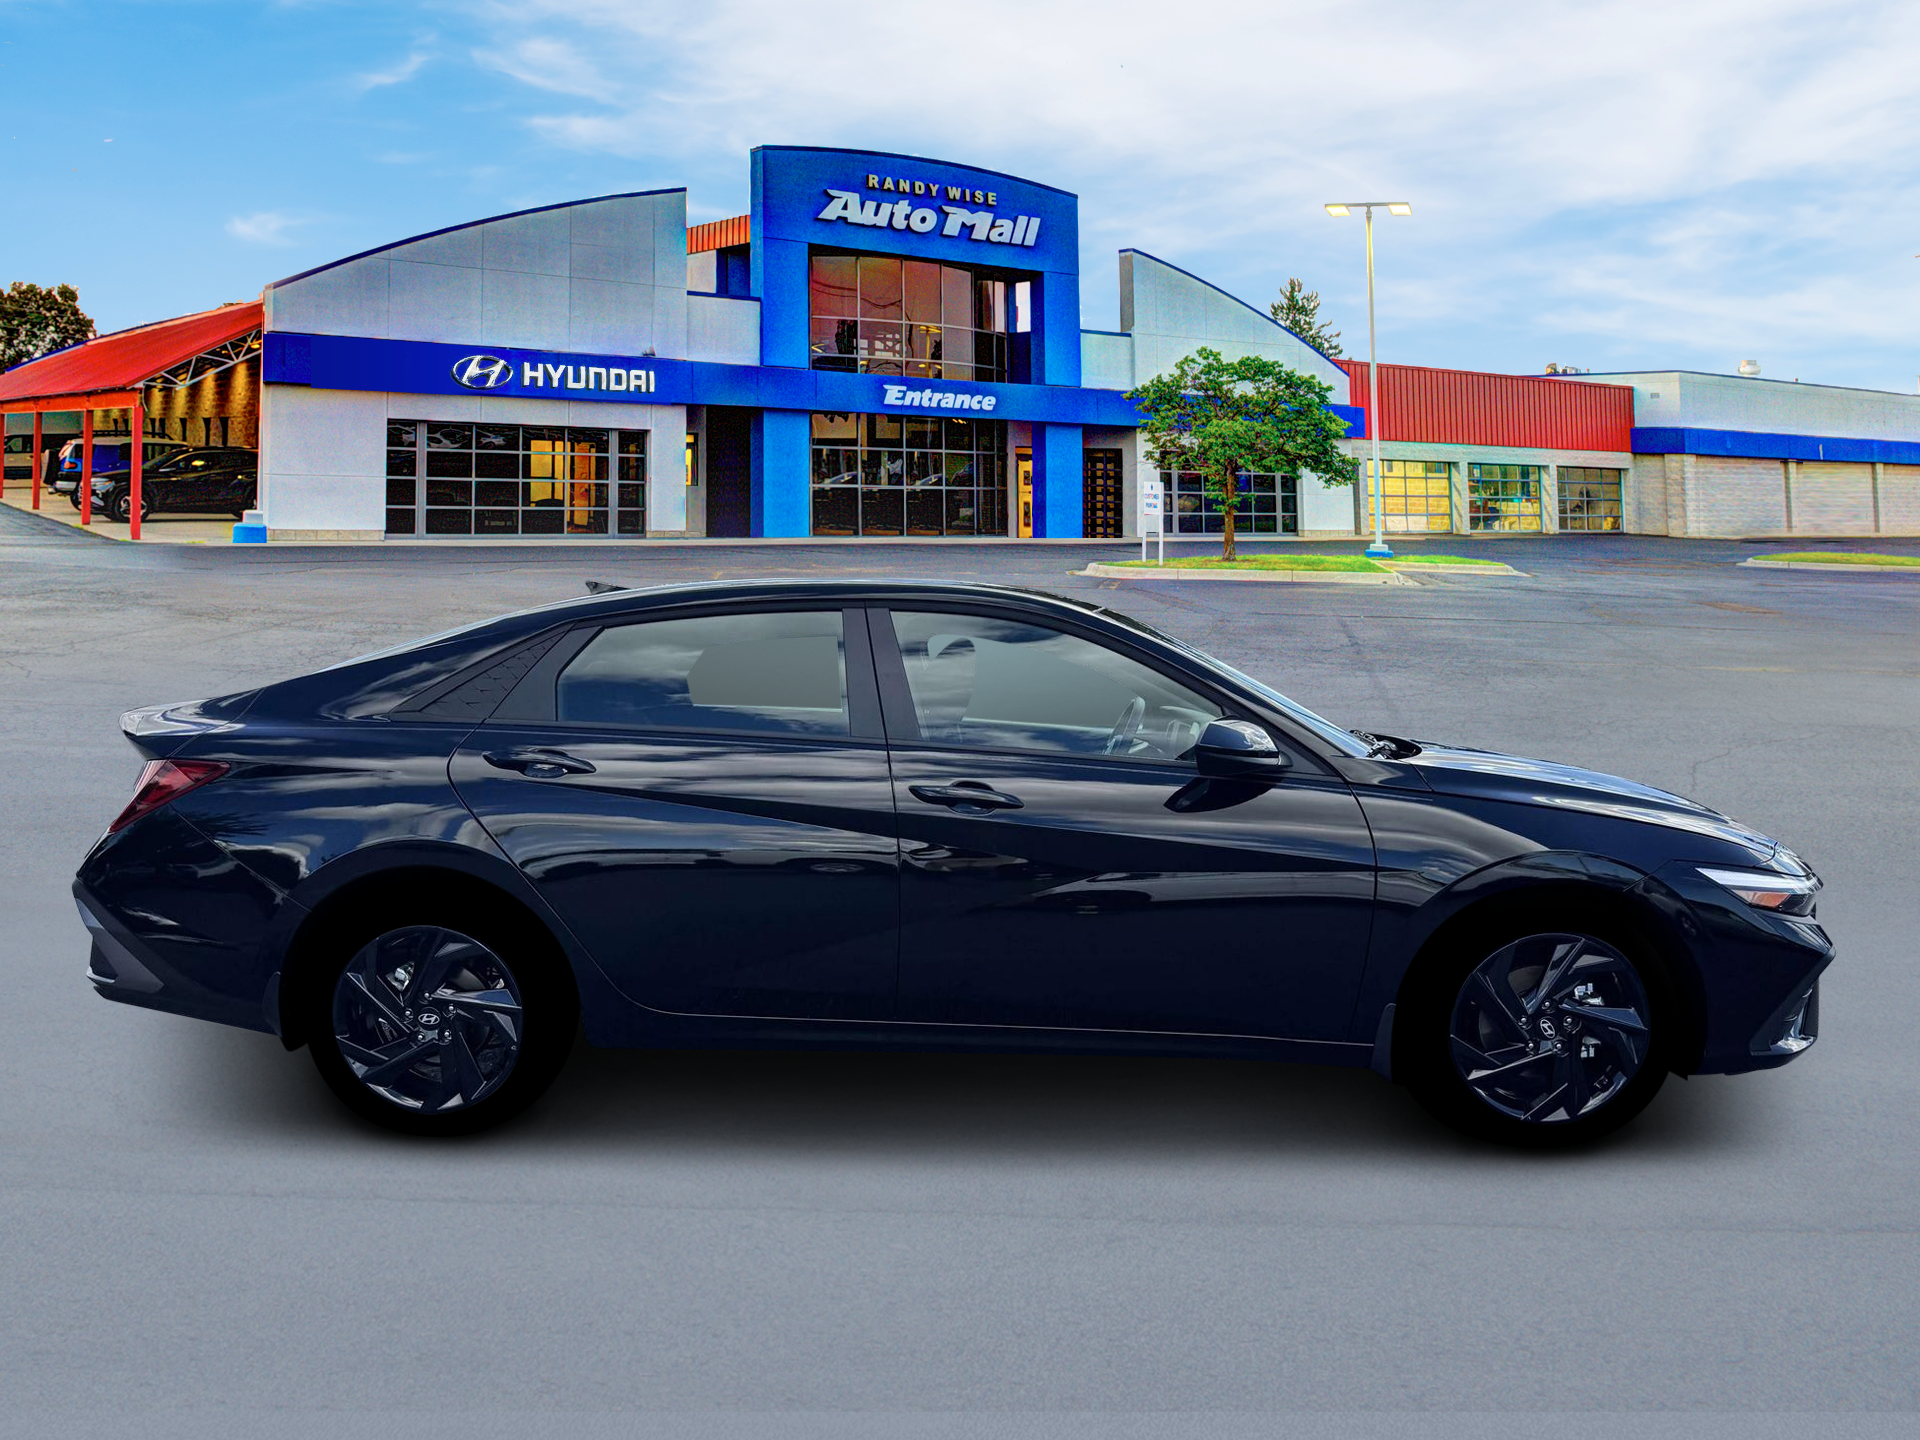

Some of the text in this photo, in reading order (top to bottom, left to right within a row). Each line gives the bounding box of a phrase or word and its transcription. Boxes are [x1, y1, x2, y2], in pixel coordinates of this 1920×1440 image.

[868, 174, 997, 205] RANDY WISE
[818, 189, 1041, 246] Auto Mall
[523, 362, 655, 392] HYUNDAI
[884, 385, 996, 410] Entrance
